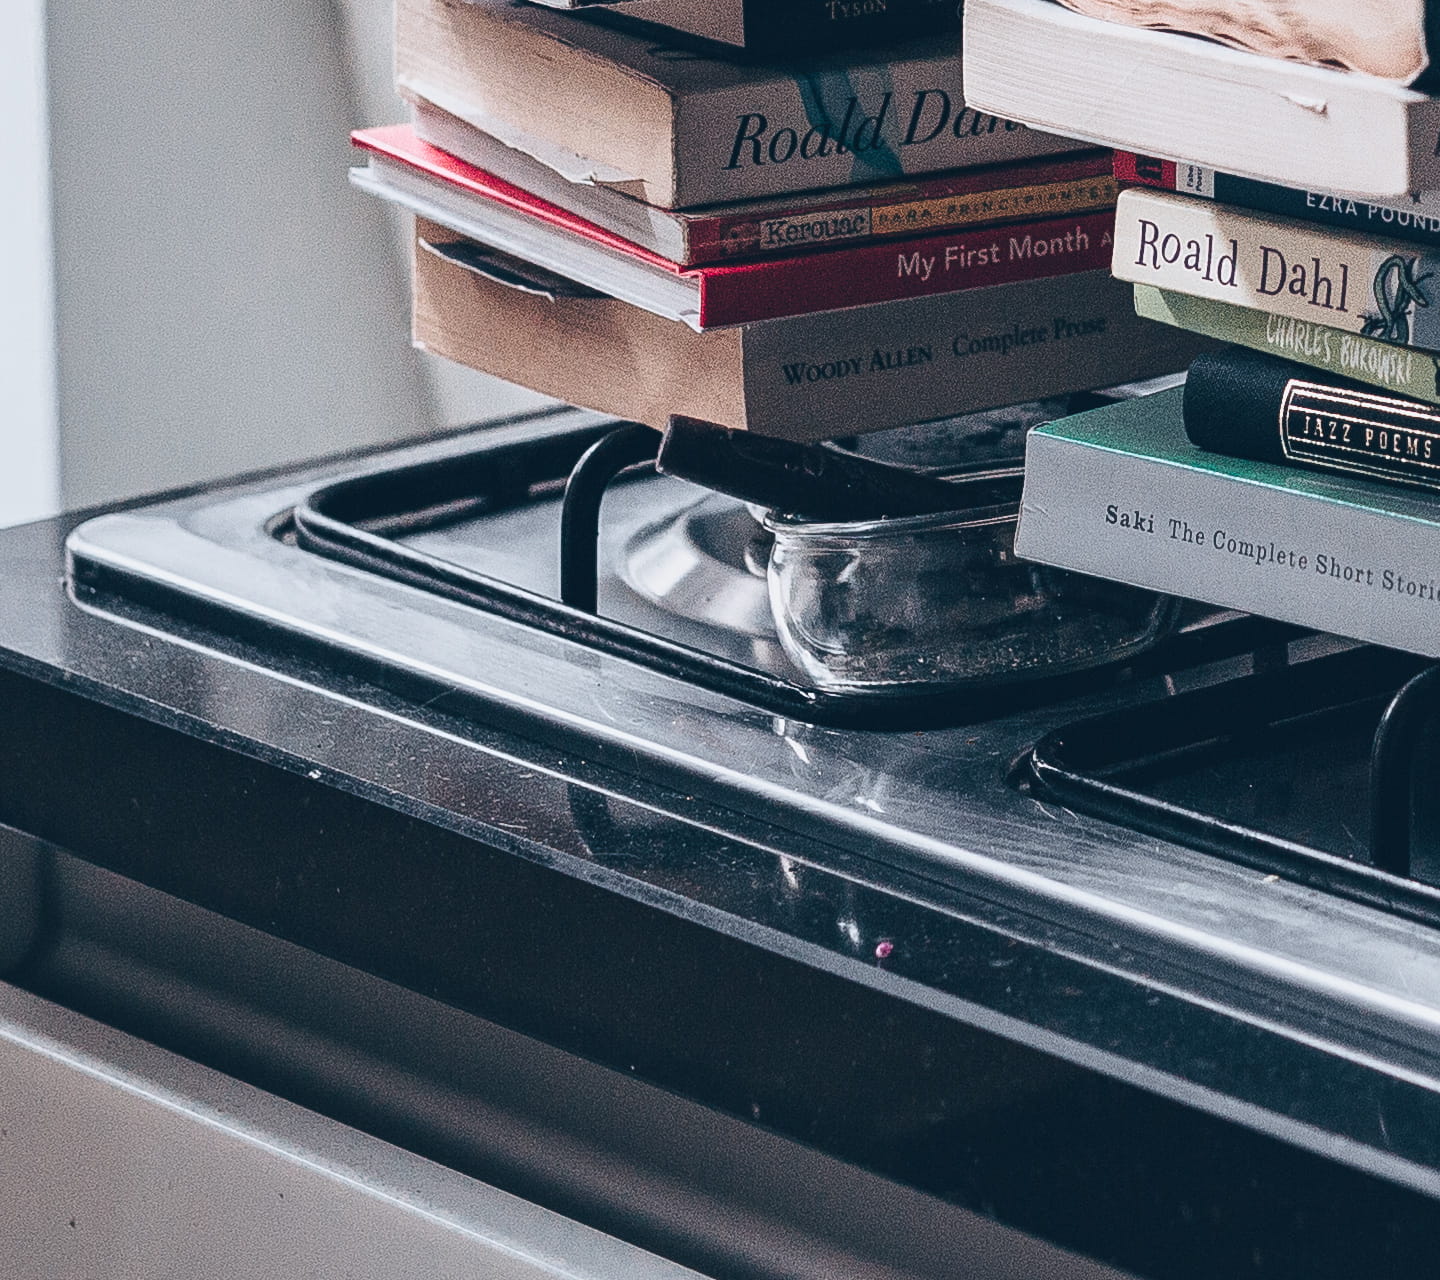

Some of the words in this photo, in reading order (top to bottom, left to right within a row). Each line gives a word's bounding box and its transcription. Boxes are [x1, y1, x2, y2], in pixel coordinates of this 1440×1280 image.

[721, 90, 894, 171] Roald
[766, 211, 867, 248] Kerouac
[878, 206, 934, 228] PARA
[946, 182, 1115, 219] PRINCIPIANTES
[1305, 189, 1358, 217] EZRA
[896, 252, 935, 283] My
[944, 241, 1001, 271] First
[1007, 224, 1090, 262] Month
[1135, 219, 1239, 288] Roald
[1256, 245, 1350, 314] Dahl
[782, 355, 863, 386] WOODY
[868, 343, 933, 372] ALLEN
[951, 323, 1048, 358] Complete
[1053, 316, 1109, 341] Prose
[1265, 314, 1334, 368] CHARLES
[1339, 336, 1413, 386] BUKOWSKI
[1303, 414, 1353, 445] JAZZ
[1364, 425, 1433, 460] POEMS
[1104, 502, 1156, 536] Saki
[1169, 516, 1206, 547] The
[1212, 527, 1309, 572] Complete
[1315, 552, 1375, 587] Short
